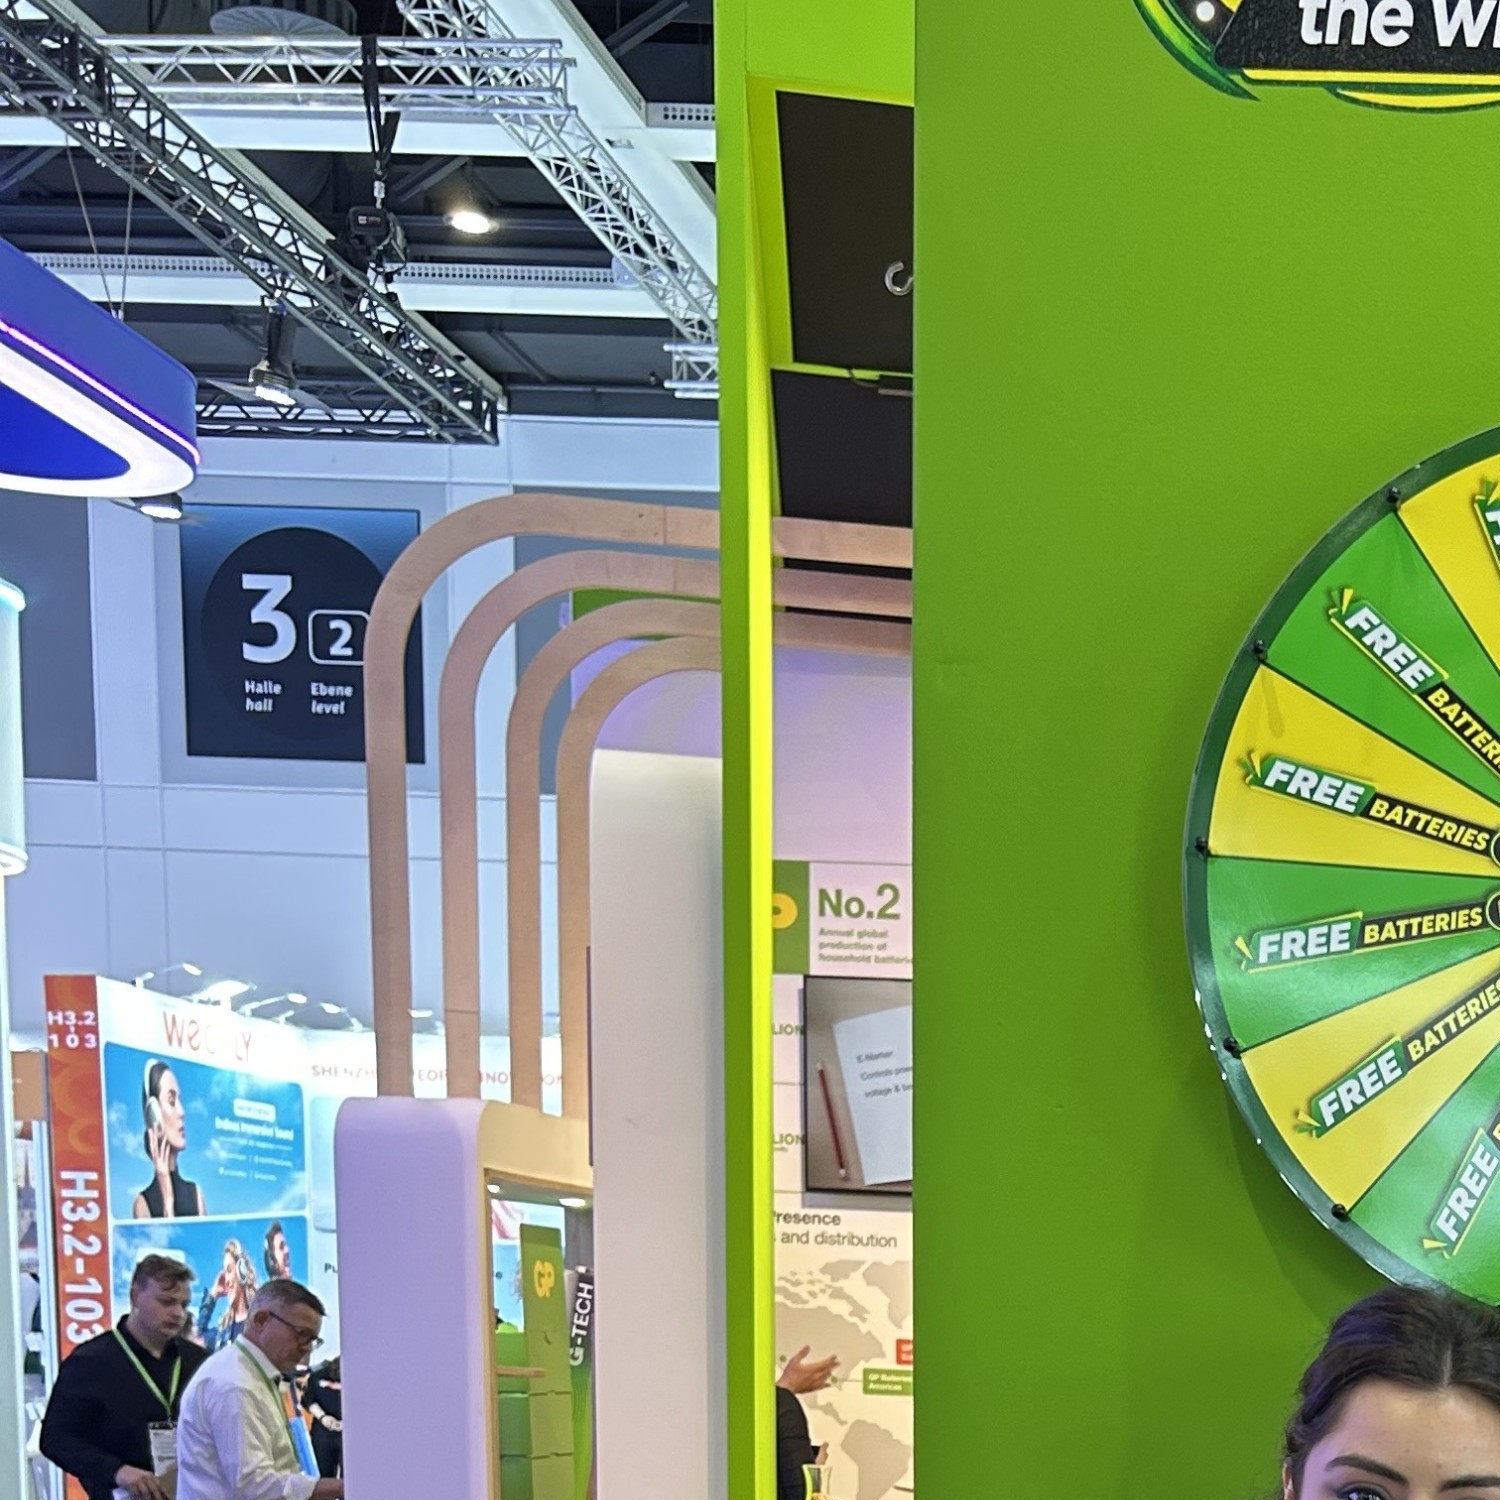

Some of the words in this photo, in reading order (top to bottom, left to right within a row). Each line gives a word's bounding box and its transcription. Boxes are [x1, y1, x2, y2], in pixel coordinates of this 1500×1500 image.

[1300, 0, 1413, 46] the
[241, 572, 297, 664] 3
[328, 619, 353, 656] 2
[1344, 606, 1435, 690] FREE
[244, 680, 283, 694] Halle
[245, 698, 273, 712] hall
[310, 682, 353, 697] Ebene
[311, 700, 346, 714] level
[1264, 759, 1365, 813] FREE
[1369, 799, 1490, 851] BATTERIES
[818, 883, 900, 920] No.2
[1258, 921, 1353, 964] FREE
[1364, 907, 1483, 944] BATTERIES
[48, 1011, 96, 1026] H3.2
[1317, 1049, 1403, 1126] FREE
[1435, 1144, 1500, 1244] FREE
[773, 1212, 841, 1226] resence
[60, 1171, 106, 1344] H3.2-103
[781, 1231, 809, 1245] and
[814, 1231, 898, 1248] distribution
[534, 1260, 555, 1297] GP
[569, 1282, 593, 1366] G-TECH
